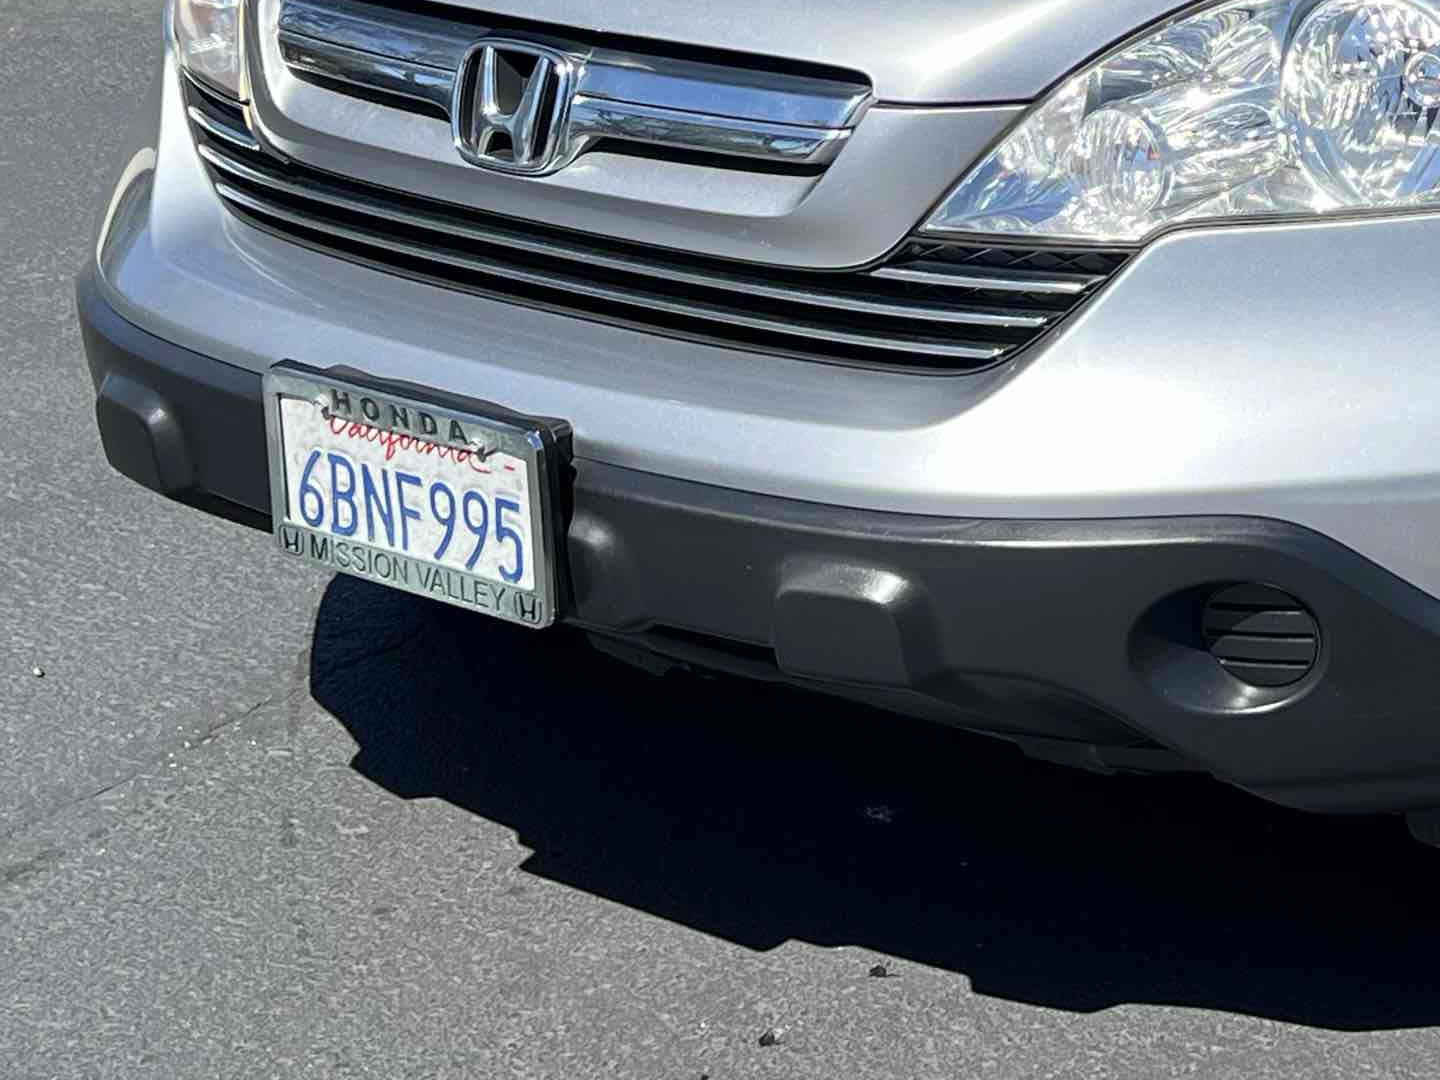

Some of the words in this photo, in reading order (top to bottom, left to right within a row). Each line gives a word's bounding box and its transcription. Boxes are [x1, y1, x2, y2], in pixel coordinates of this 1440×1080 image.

[330, 388, 469, 446] HONDA
[298, 449, 524, 583] 6BNF995
[309, 534, 410, 586] MISSION
[415, 560, 507, 611] VALLEY
